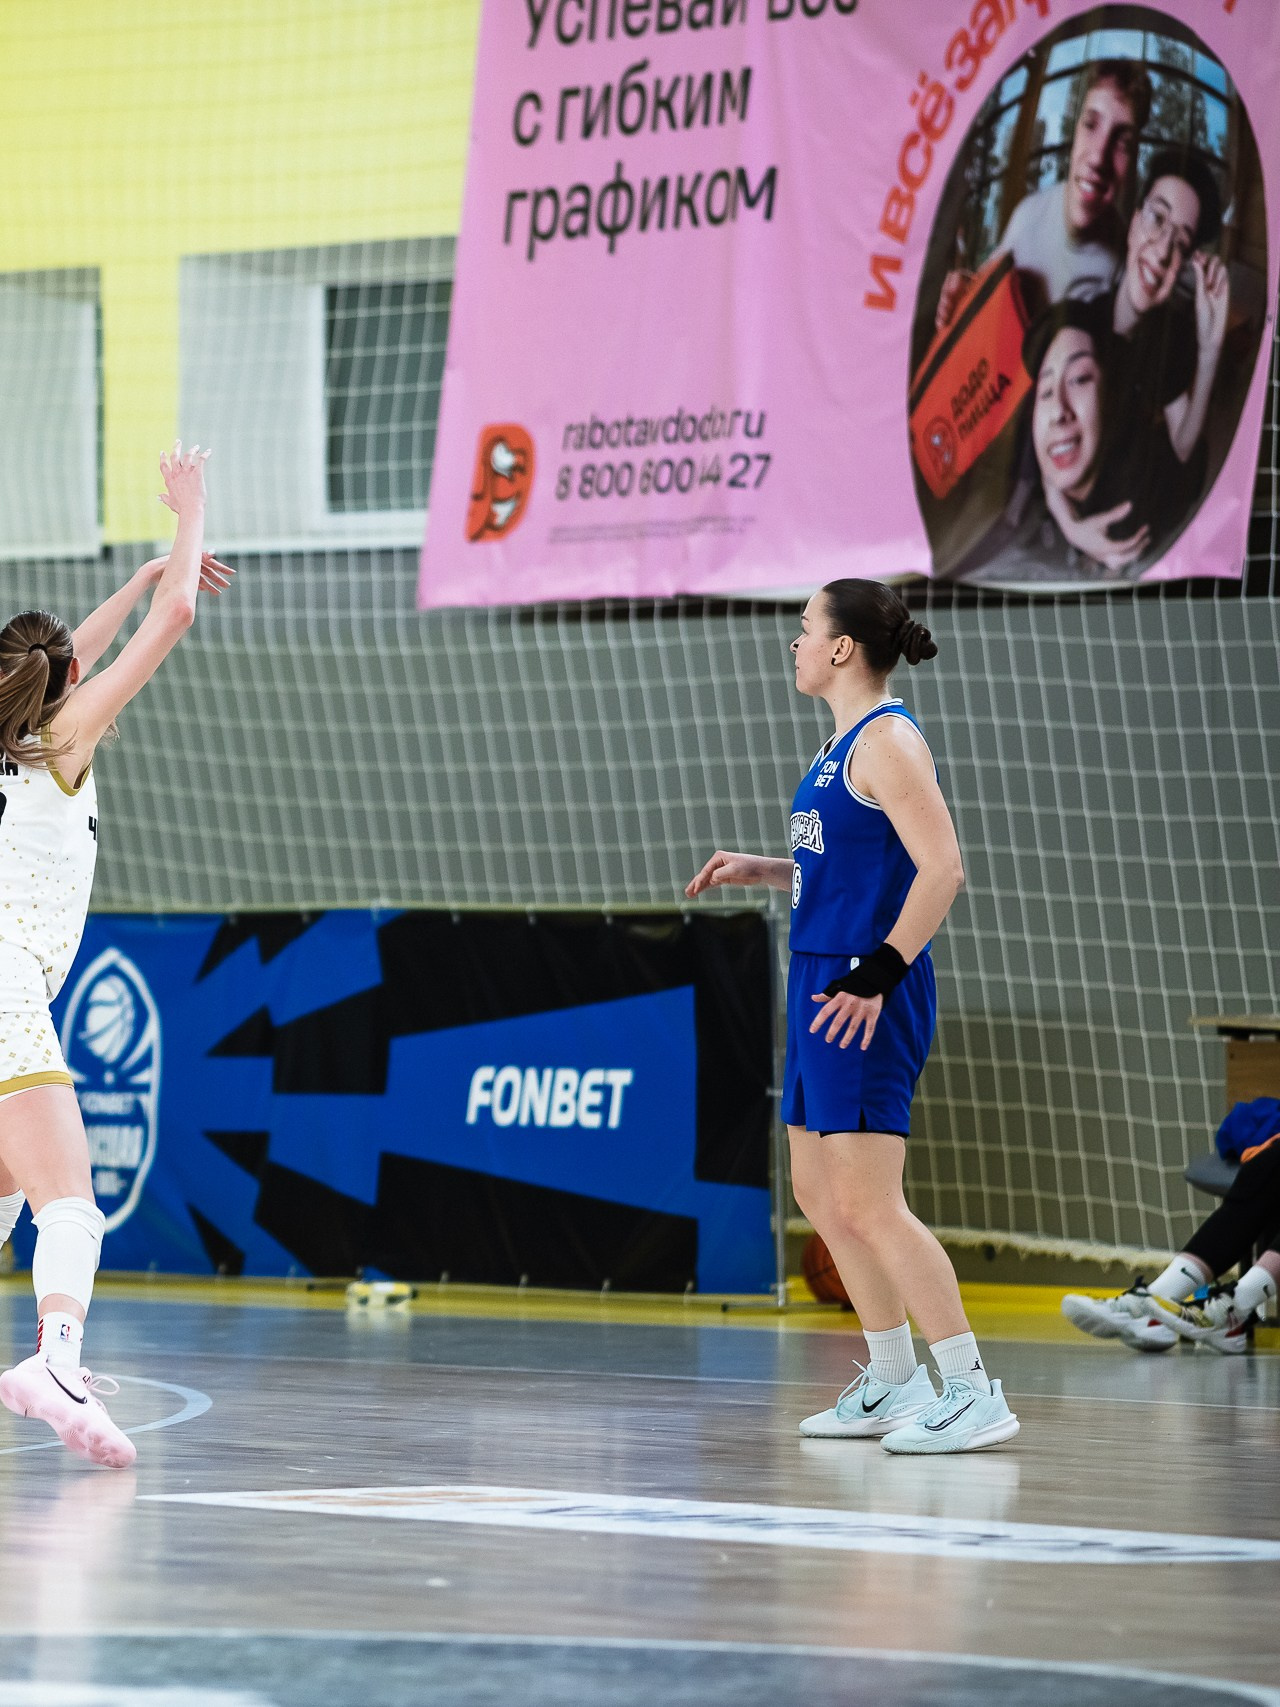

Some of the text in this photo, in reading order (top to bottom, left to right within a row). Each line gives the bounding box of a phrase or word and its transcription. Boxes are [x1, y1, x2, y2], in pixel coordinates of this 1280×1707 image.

[512, 57, 752, 147] с гибким
[503, 160, 778, 262] графиком
[578, 462, 634, 499] 800
[726, 453, 771, 489] 27
[465, 1065, 634, 1130] FONBET
